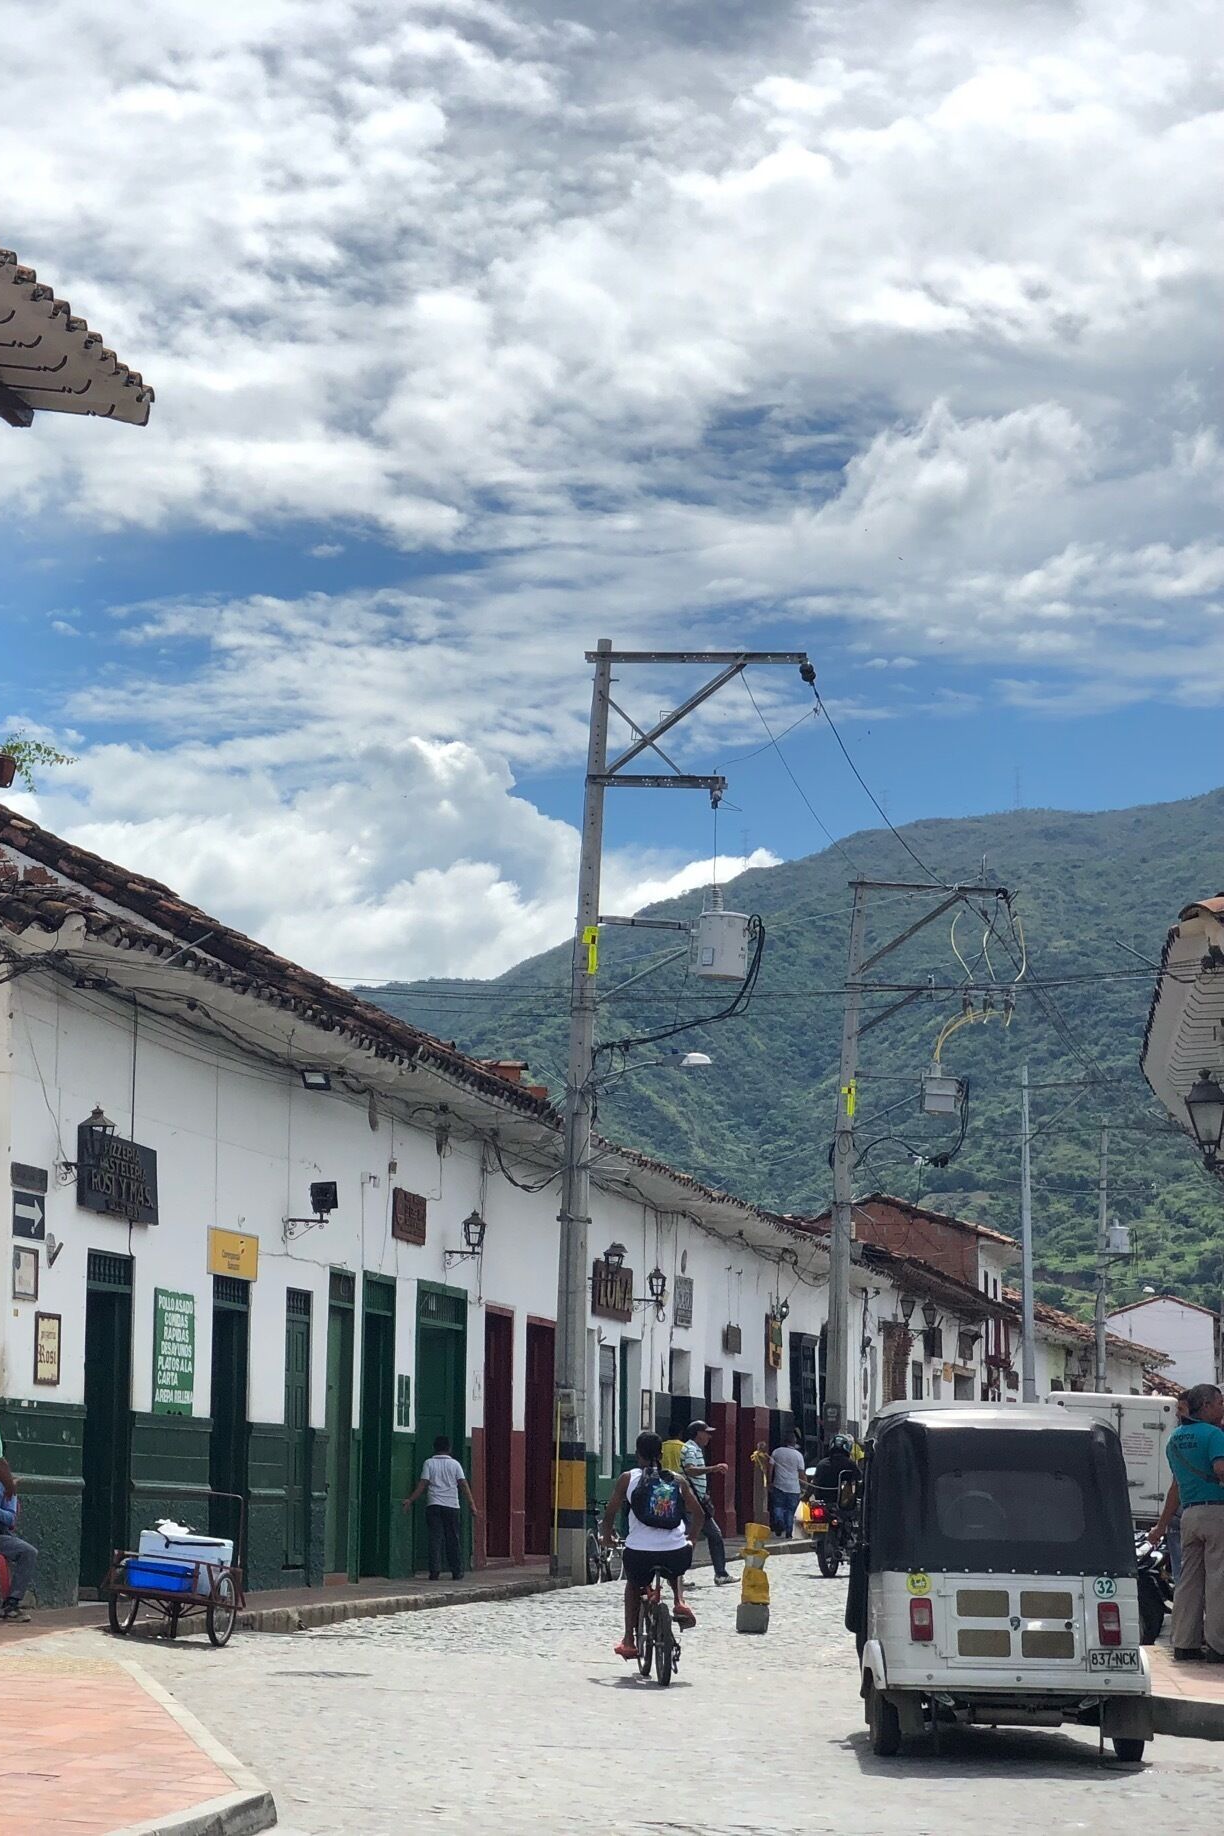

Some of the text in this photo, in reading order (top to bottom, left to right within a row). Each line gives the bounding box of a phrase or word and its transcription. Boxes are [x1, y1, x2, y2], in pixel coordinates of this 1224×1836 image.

[158, 1295, 193, 1314] POLLO ASADO
[164, 1312, 189, 1328] COMIDAS
[163, 1326, 189, 1343] RAPIDAS
[157, 1355, 179, 1371] PLATOS
[157, 1371, 178, 1386] CARTA
[155, 1388, 173, 1403] AREPA
[1097, 1580, 1113, 1594] 32
